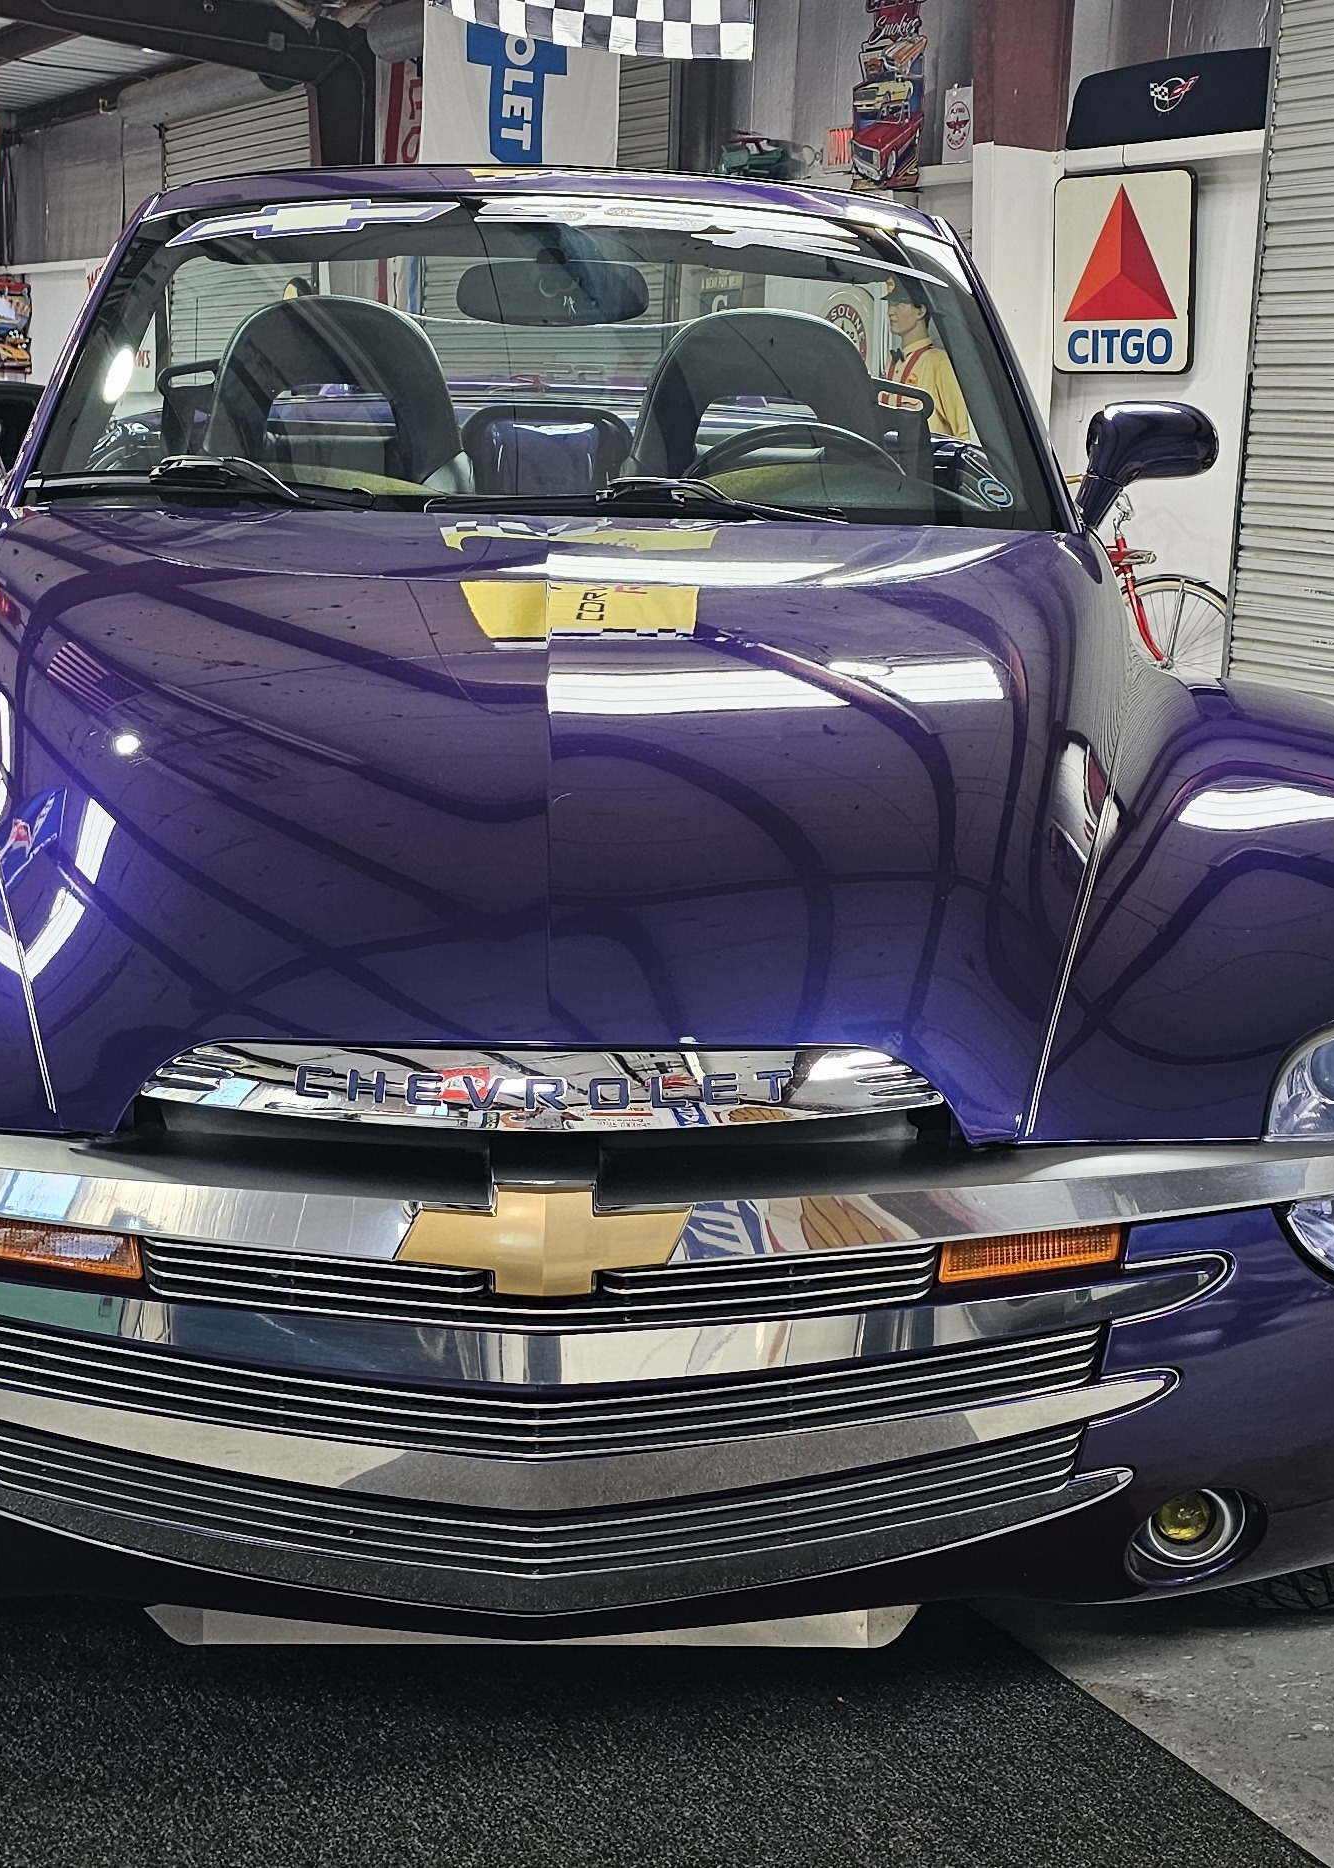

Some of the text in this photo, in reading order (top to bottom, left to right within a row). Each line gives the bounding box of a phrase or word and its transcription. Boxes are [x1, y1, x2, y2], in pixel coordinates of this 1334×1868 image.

[500, 34, 536, 151] OLET
[1067, 327, 1174, 365] CITGO
[293, 1064, 794, 1111] CHEVROLET
